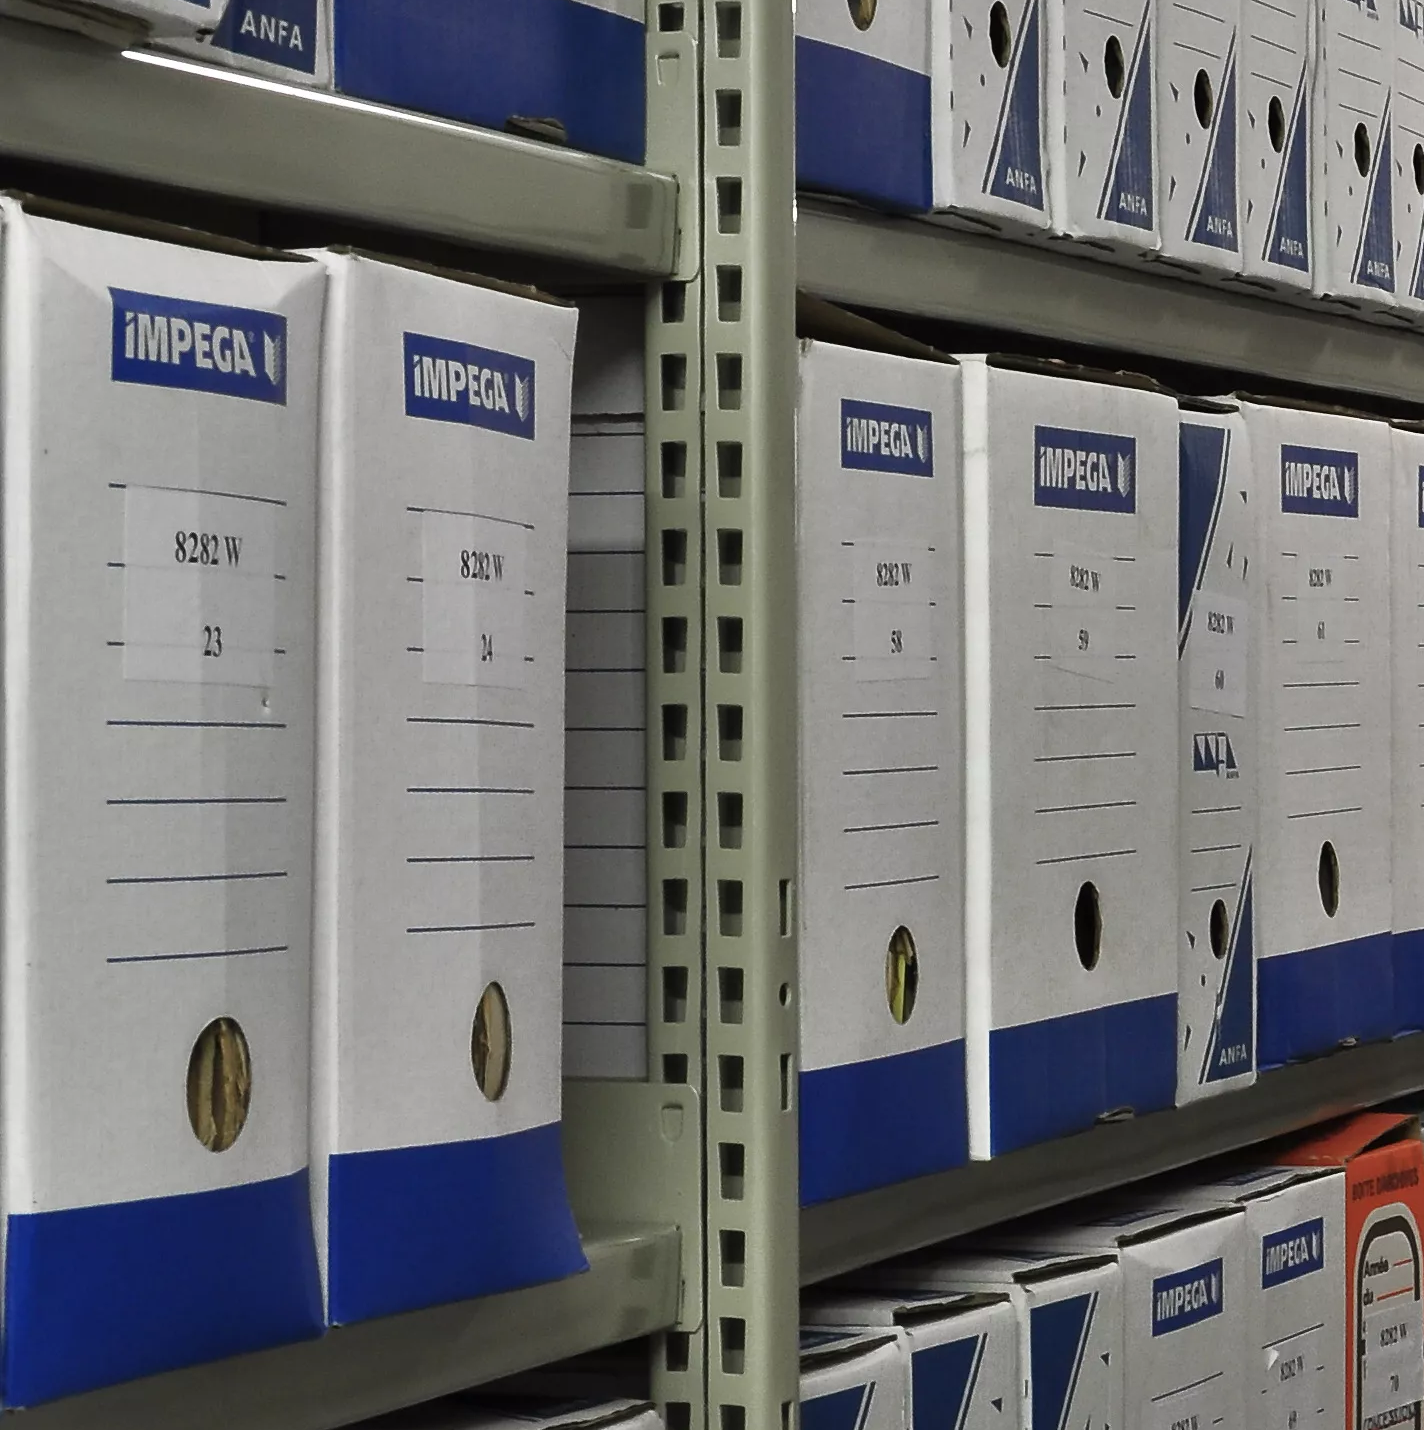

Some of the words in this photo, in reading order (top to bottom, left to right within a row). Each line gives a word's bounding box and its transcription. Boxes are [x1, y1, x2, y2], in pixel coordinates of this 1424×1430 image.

[241, 11, 302, 51] ANFA
[1006, 168, 1036, 194] ANFA
[1119, 191, 1147, 215] ANFA
[1206, 216, 1233, 237] ANFA
[1280, 237, 1304, 258] ANFA
[1367, 261, 1390, 278] ANFA
[175, 531, 218, 566] 8282
[223, 536, 242, 568] W
[460, 550, 491, 580] 8282
[491, 555, 504, 581] W
[876, 563, 899, 587] 8282
[901, 562, 912, 583] W
[1070, 565, 1089, 591] 8282
[1090, 573, 1101, 592] W
[1208, 612, 1225, 634] 8282
[1226, 617, 1234, 635] W
[203, 626, 222, 657] 23
[481, 634, 493, 660] 24
[891, 630, 902, 653] 58
[1078, 630, 1089, 650] 59
[1215, 671, 1224, 689] 60
[1219, 1045, 1246, 1067] ANFA
[1380, 1327, 1398, 1347] 8282
[1280, 1359, 1296, 1381] 8282
